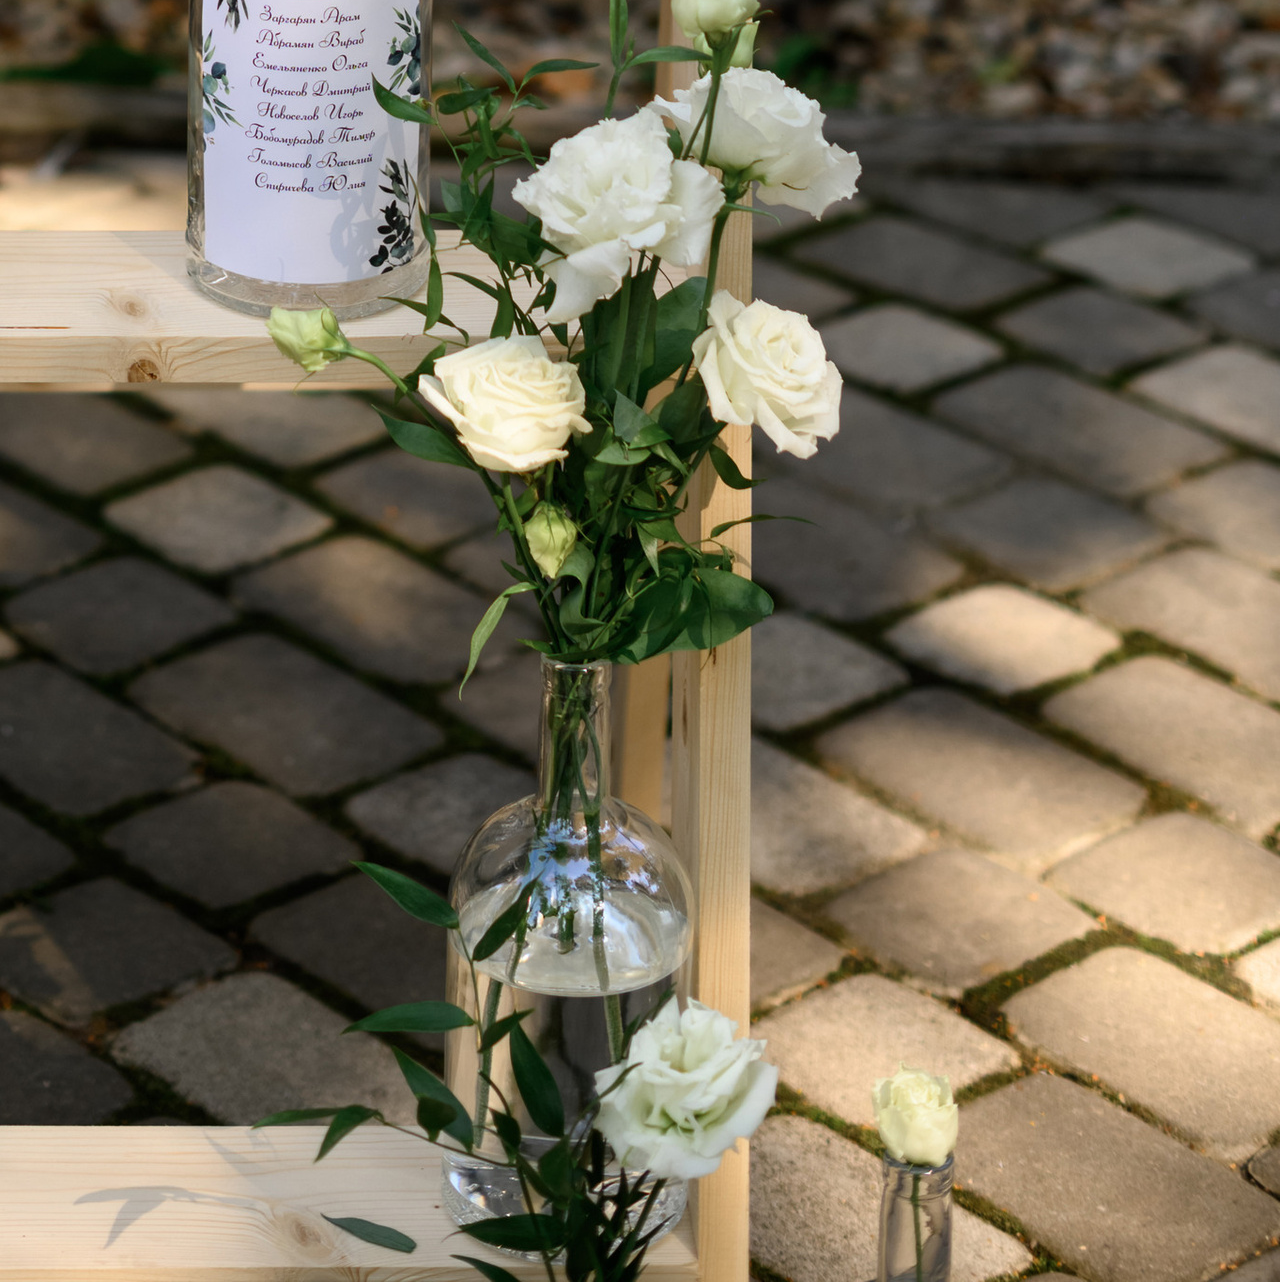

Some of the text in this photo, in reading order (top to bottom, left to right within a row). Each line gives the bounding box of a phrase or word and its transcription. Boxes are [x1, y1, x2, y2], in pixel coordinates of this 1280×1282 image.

[260, 5, 360, 25] Заргарян Арам
[256, 28, 314, 49] Абрамян
[252, 52, 368, 73] Емельяненко Ольга
[250, 75, 371, 97] Черкасов Дмитрий
[257, 101, 364, 120] Новоселов Игорь
[245, 123, 376, 146] Бобомурадов Тимур
[247, 148, 373, 169] Голомысов Василий
[254, 172, 366, 193] Спиричева Юлия
